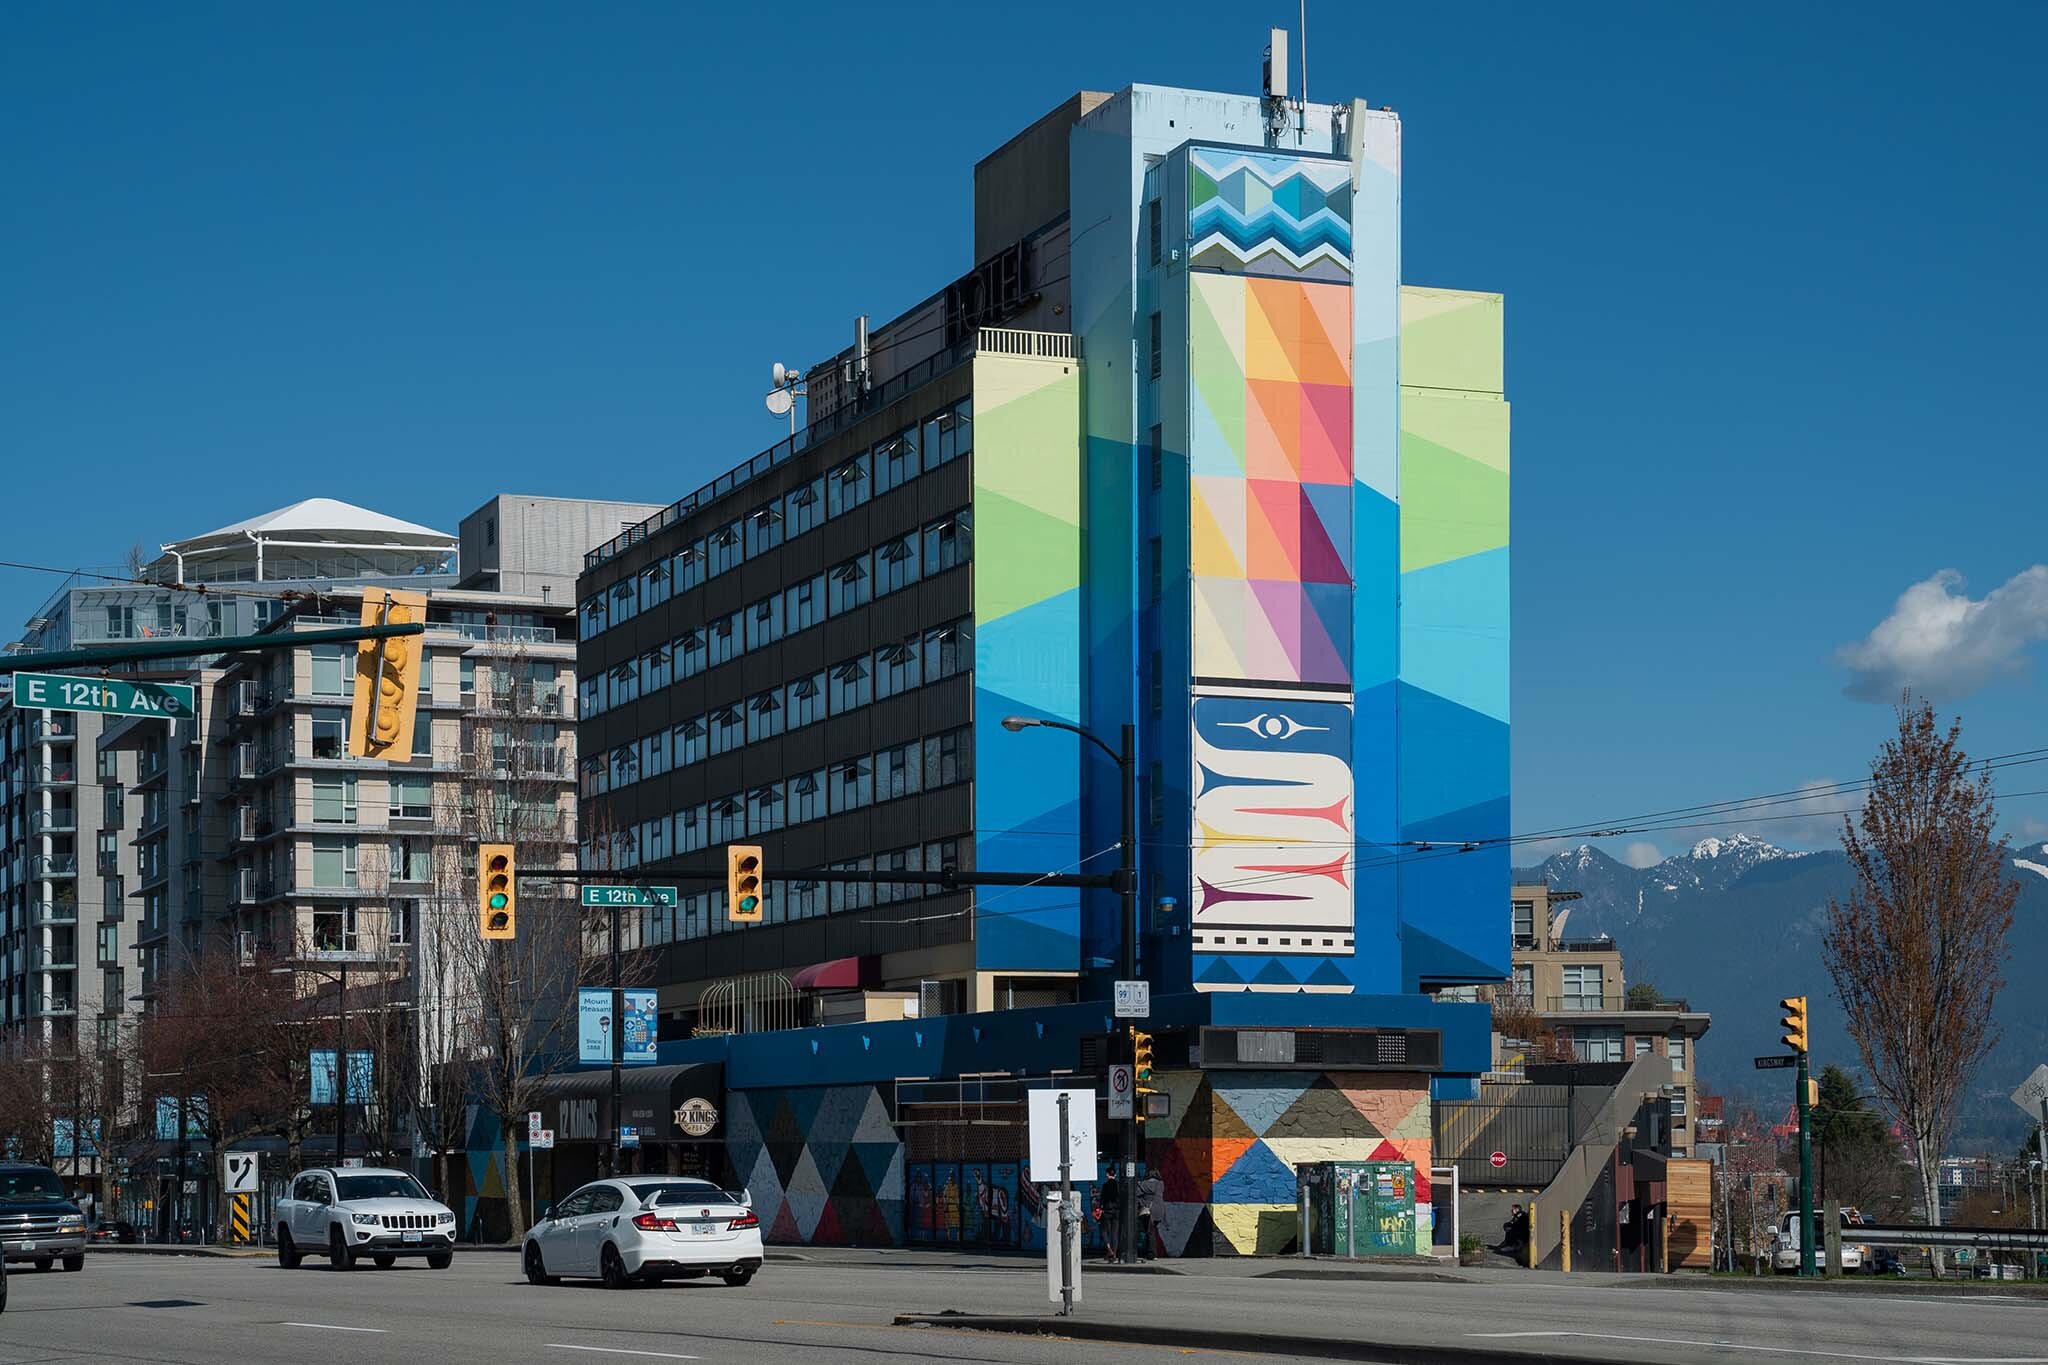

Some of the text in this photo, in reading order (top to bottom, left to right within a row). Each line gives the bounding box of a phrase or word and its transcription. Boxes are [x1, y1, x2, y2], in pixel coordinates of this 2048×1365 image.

[29, 680, 181, 713] E 12th Ave
[589, 889, 670, 903] E 12th Ave
[559, 1099, 569, 1139] 12
[677, 1110, 718, 1123] 12 KINGS
